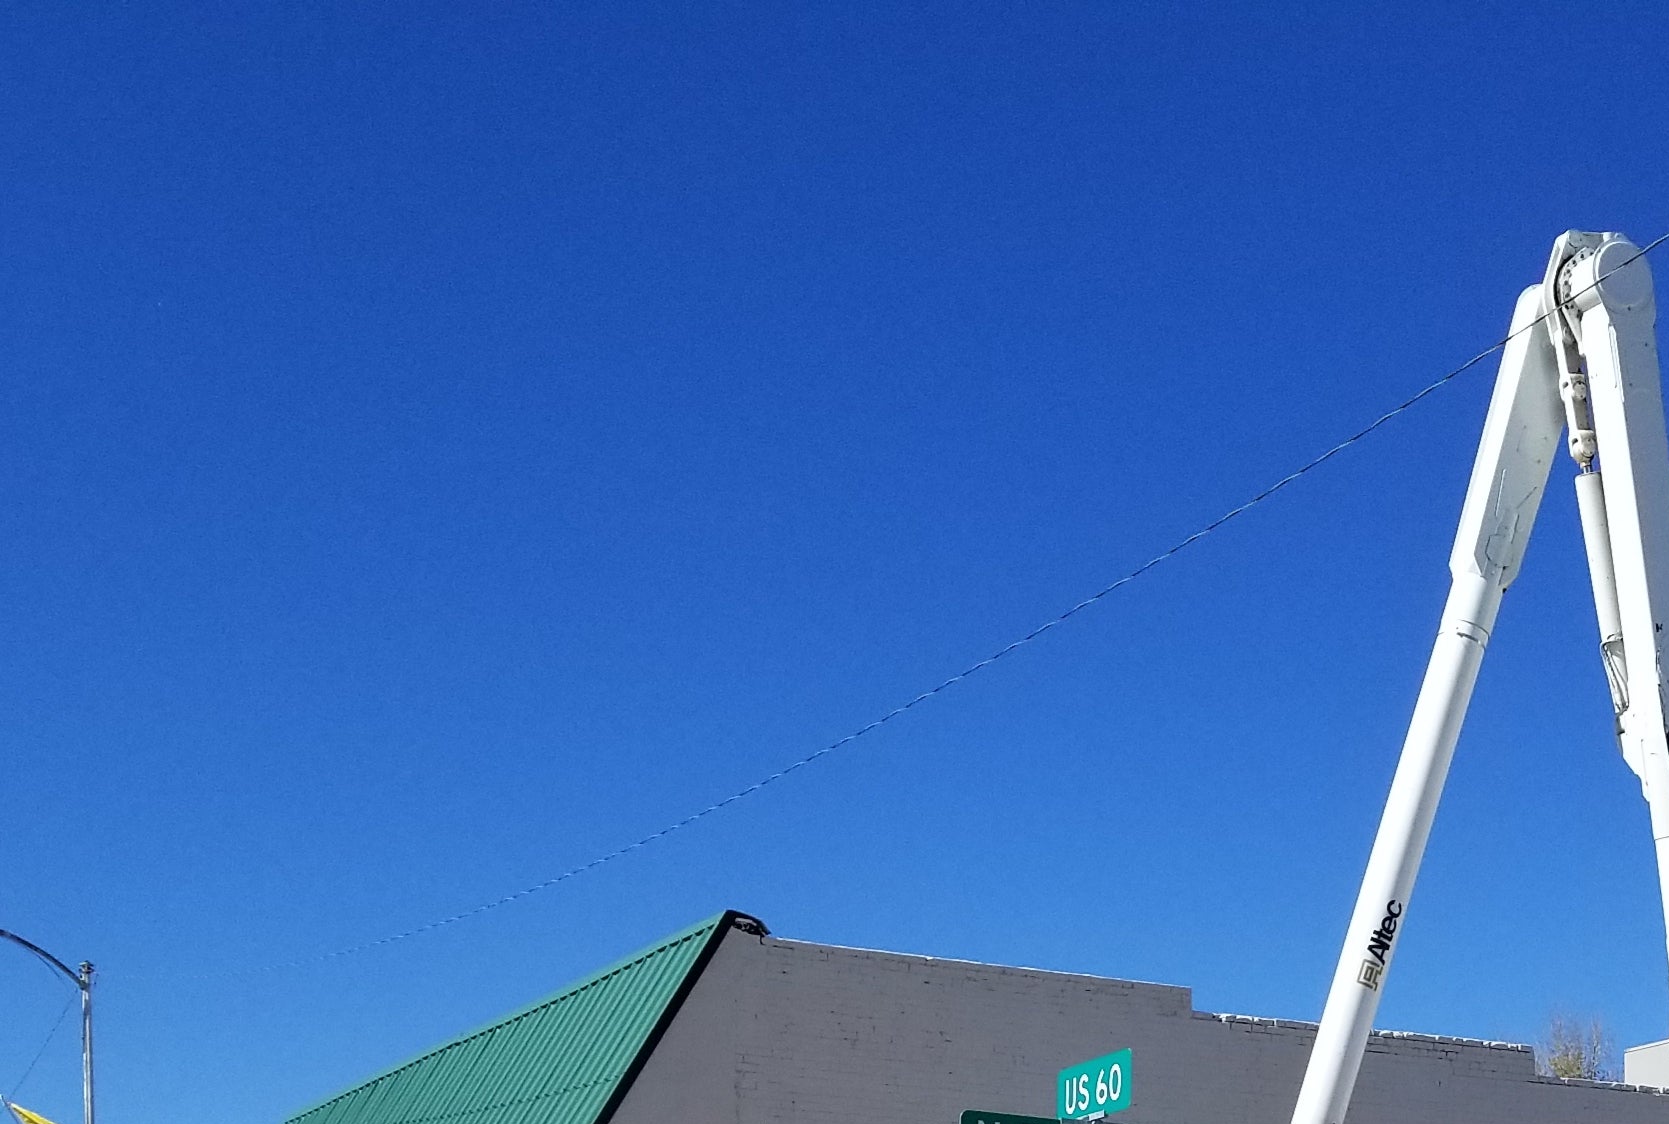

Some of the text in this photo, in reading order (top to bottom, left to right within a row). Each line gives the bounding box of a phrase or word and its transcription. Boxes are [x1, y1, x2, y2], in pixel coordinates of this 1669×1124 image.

[1367, 899, 1402, 966] Altec
[1065, 1063, 1122, 1115] US 60
